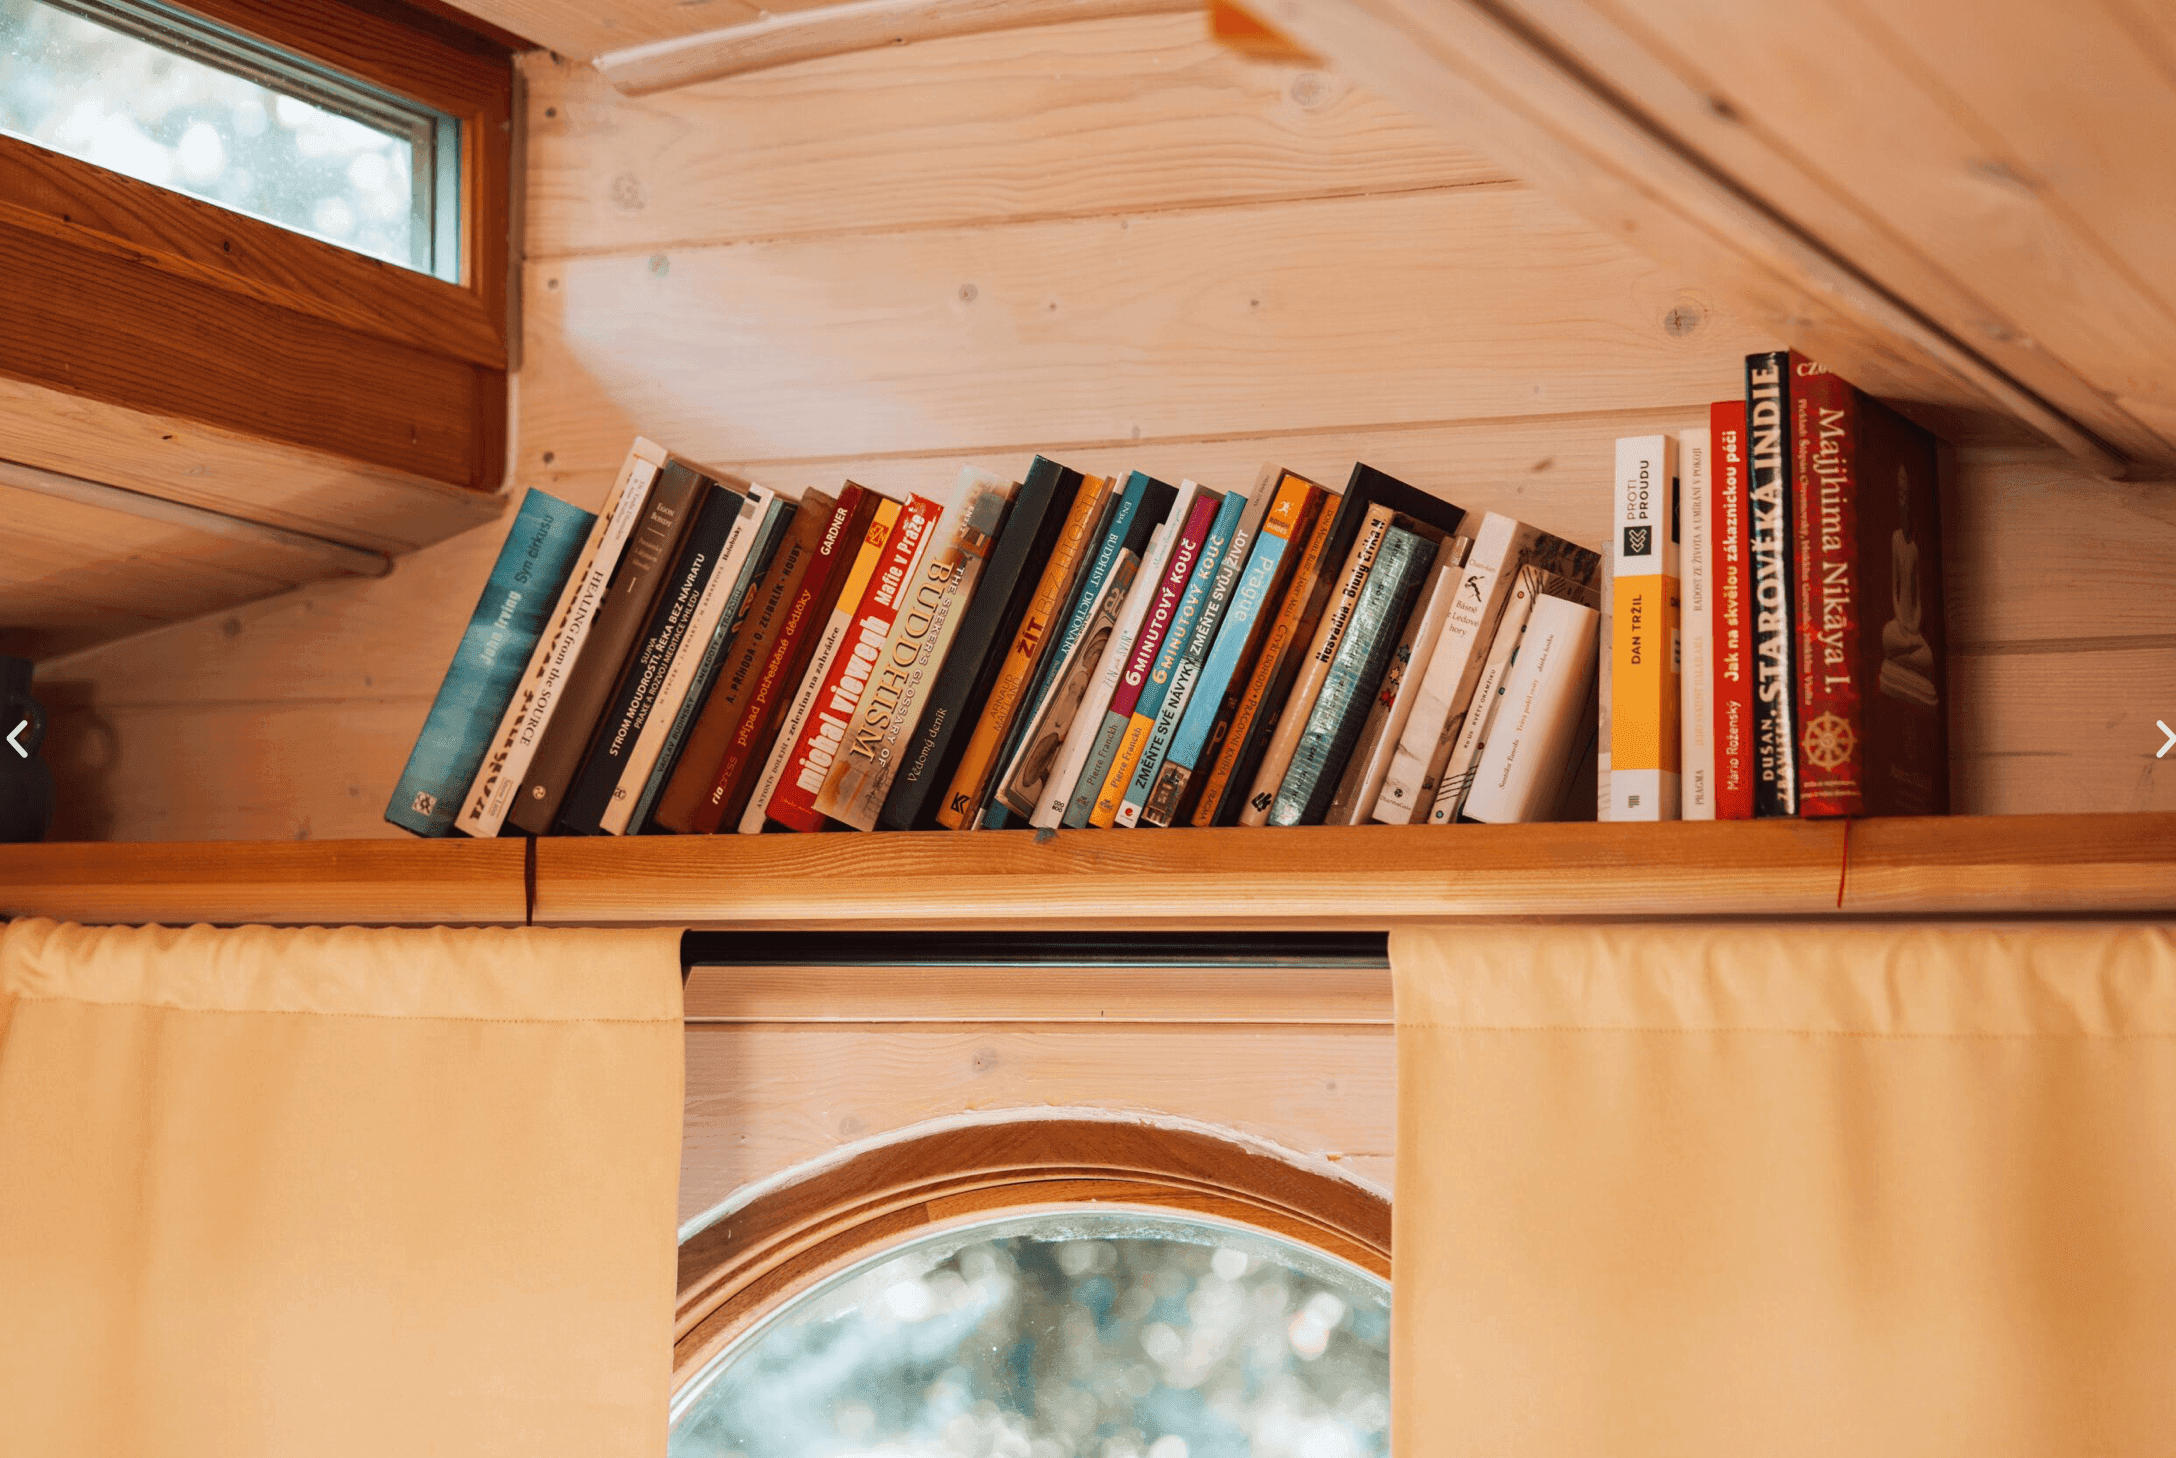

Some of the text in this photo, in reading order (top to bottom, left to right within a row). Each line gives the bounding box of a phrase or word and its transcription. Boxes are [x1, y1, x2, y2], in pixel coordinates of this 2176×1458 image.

[1626, 479, 1636, 520] PROTI
[1638, 460, 1648, 519] PROUDU
[1810, 405, 1850, 553] Majjhima
[512, 511, 557, 586] Syn cirkusu
[720, 523, 743, 562] Holubinky
[780, 541, 804, 576] HOUBY
[817, 506, 851, 557] GARDNER
[874, 512, 927, 607] Mafie v Praze
[1088, 532, 1119, 588] BUDDHIST
[1166, 535, 1198, 584] KOUČ
[1193, 534, 1224, 581] KOUČ
[1722, 431, 1740, 681] Jak na skvělou zákaznickou péči
[1749, 365, 1785, 702] STAROVĚKÁ INDIE
[567, 568, 604, 635] HEALING
[946, 565, 964, 594] THE
[1186, 528, 1249, 656] ZMĚŇTE SVŮJ ŽIVOT
[1227, 553, 1278, 623] Prague
[1693, 578, 1702, 610] RADOST
[477, 629, 504, 665] John
[492, 588, 523, 630] Irving
[1012, 614, 1046, 659] ŽÍT
[1033, 572, 1065, 616] BEZ
[1059, 590, 1095, 656] DICTIONARY
[1629, 593, 1642, 664] DAN TRŽIL
[544, 666, 563, 689] the
[553, 634, 577, 667] from
[608, 552, 706, 757] STROM MOUDROSTI, ŘEKA BEZ NÁVRATU
[632, 589, 701, 729] PRAXE A ROZVOJ MEDITACE VHLEDU
[639, 636, 658, 665] SUJIVA
[694, 639, 720, 686] ANEKDOTY
[726, 645, 759, 692] PŘÍHODA
[733, 587, 814, 747] případ potřeštěné dědičky
[784, 625, 841, 736] zelenina na zahrádce
[848, 552, 954, 766] BUDDHISM
[1250, 652, 1274, 692] DOHODY
[518, 688, 553, 748] SOURCE
[788, 710, 850, 794] michal
[822, 611, 895, 718] viewegh
[884, 668, 922, 744] GLOSSARY
[987, 673, 1014, 718] ARNAUD
[992, 676, 1023, 731] MAITLAND
[875, 745, 891, 767] OF
[905, 706, 948, 783] Vědomý deník
[1085, 723, 1120, 786] Pierre Franckh
[1109, 760, 1128, 788] Pierre
[1120, 724, 1143, 761] Franckh
[1129, 734, 1165, 789] ZMĚŇTE
[1152, 708, 1174, 735] SVÉ
[1216, 746, 1236, 777] KNIHA
[1758, 718, 1774, 780] DUŠAN
[753, 774, 775, 809] ANTONÍN
[1694, 769, 1704, 804] PRAGMA
